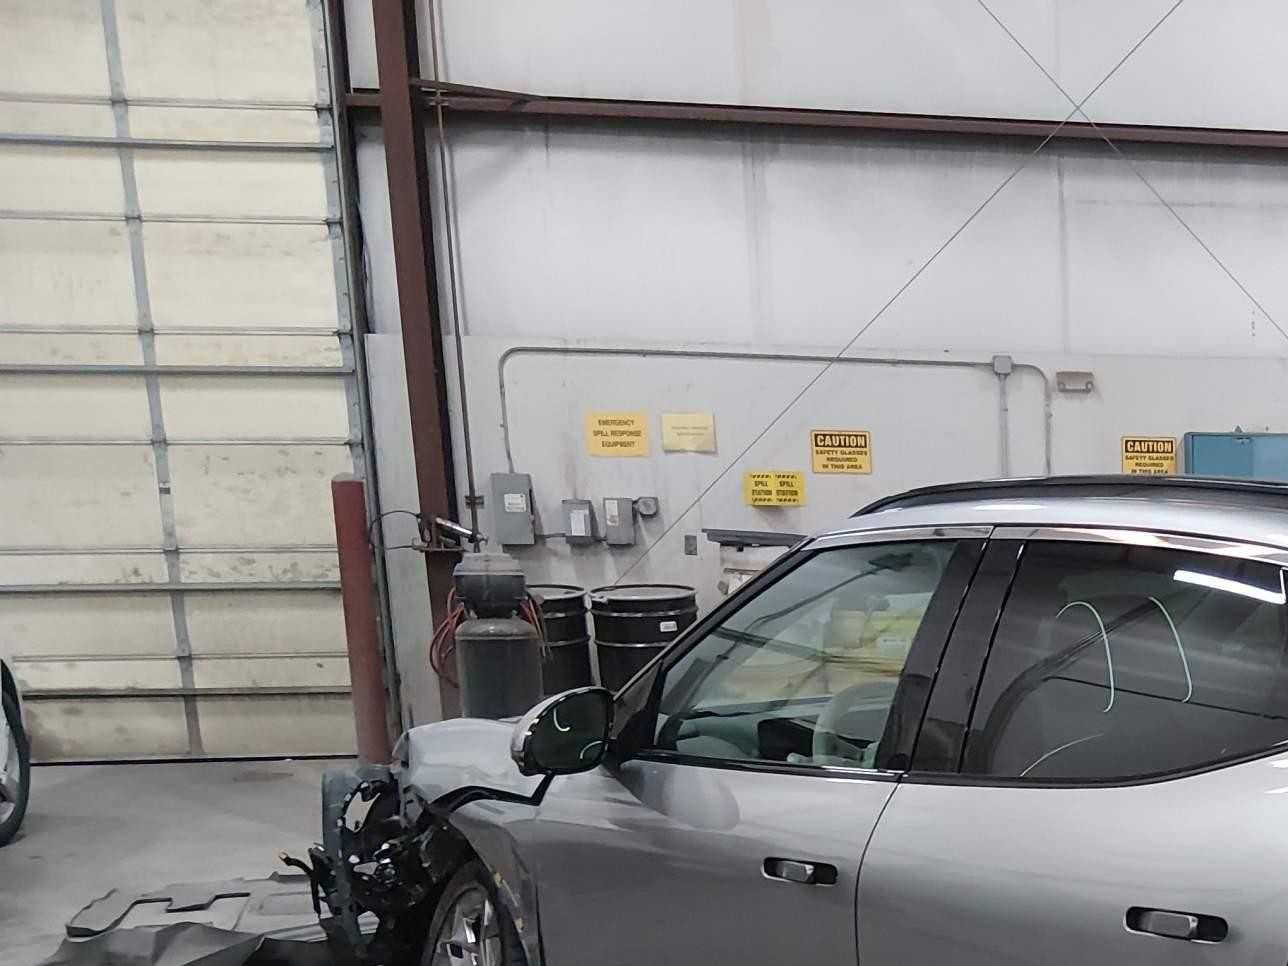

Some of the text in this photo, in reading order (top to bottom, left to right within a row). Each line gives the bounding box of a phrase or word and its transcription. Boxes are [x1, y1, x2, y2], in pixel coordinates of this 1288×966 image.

[601, 440, 635, 448] EQUIPMENT
[817, 435, 865, 447] CAUTION
[1127, 441, 1172, 453] CAUTION
